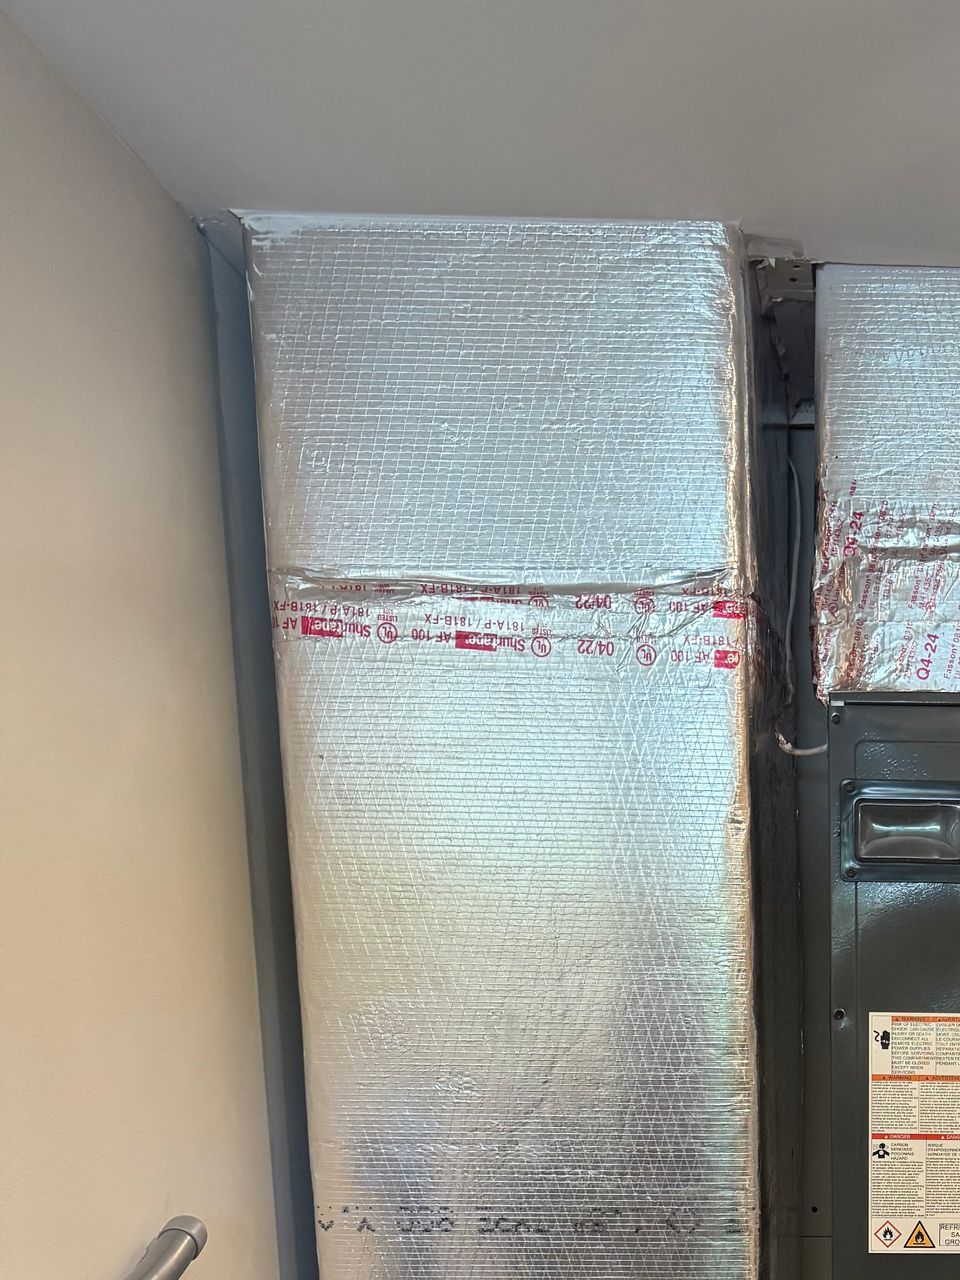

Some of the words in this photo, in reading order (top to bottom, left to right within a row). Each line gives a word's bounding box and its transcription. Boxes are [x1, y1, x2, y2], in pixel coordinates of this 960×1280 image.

[424, 613, 473, 627] 181B-FX
[465, 633, 526, 652] Shurtape
[577, 639, 615, 656] 04/22
[916, 633, 940, 681] Q4-24
